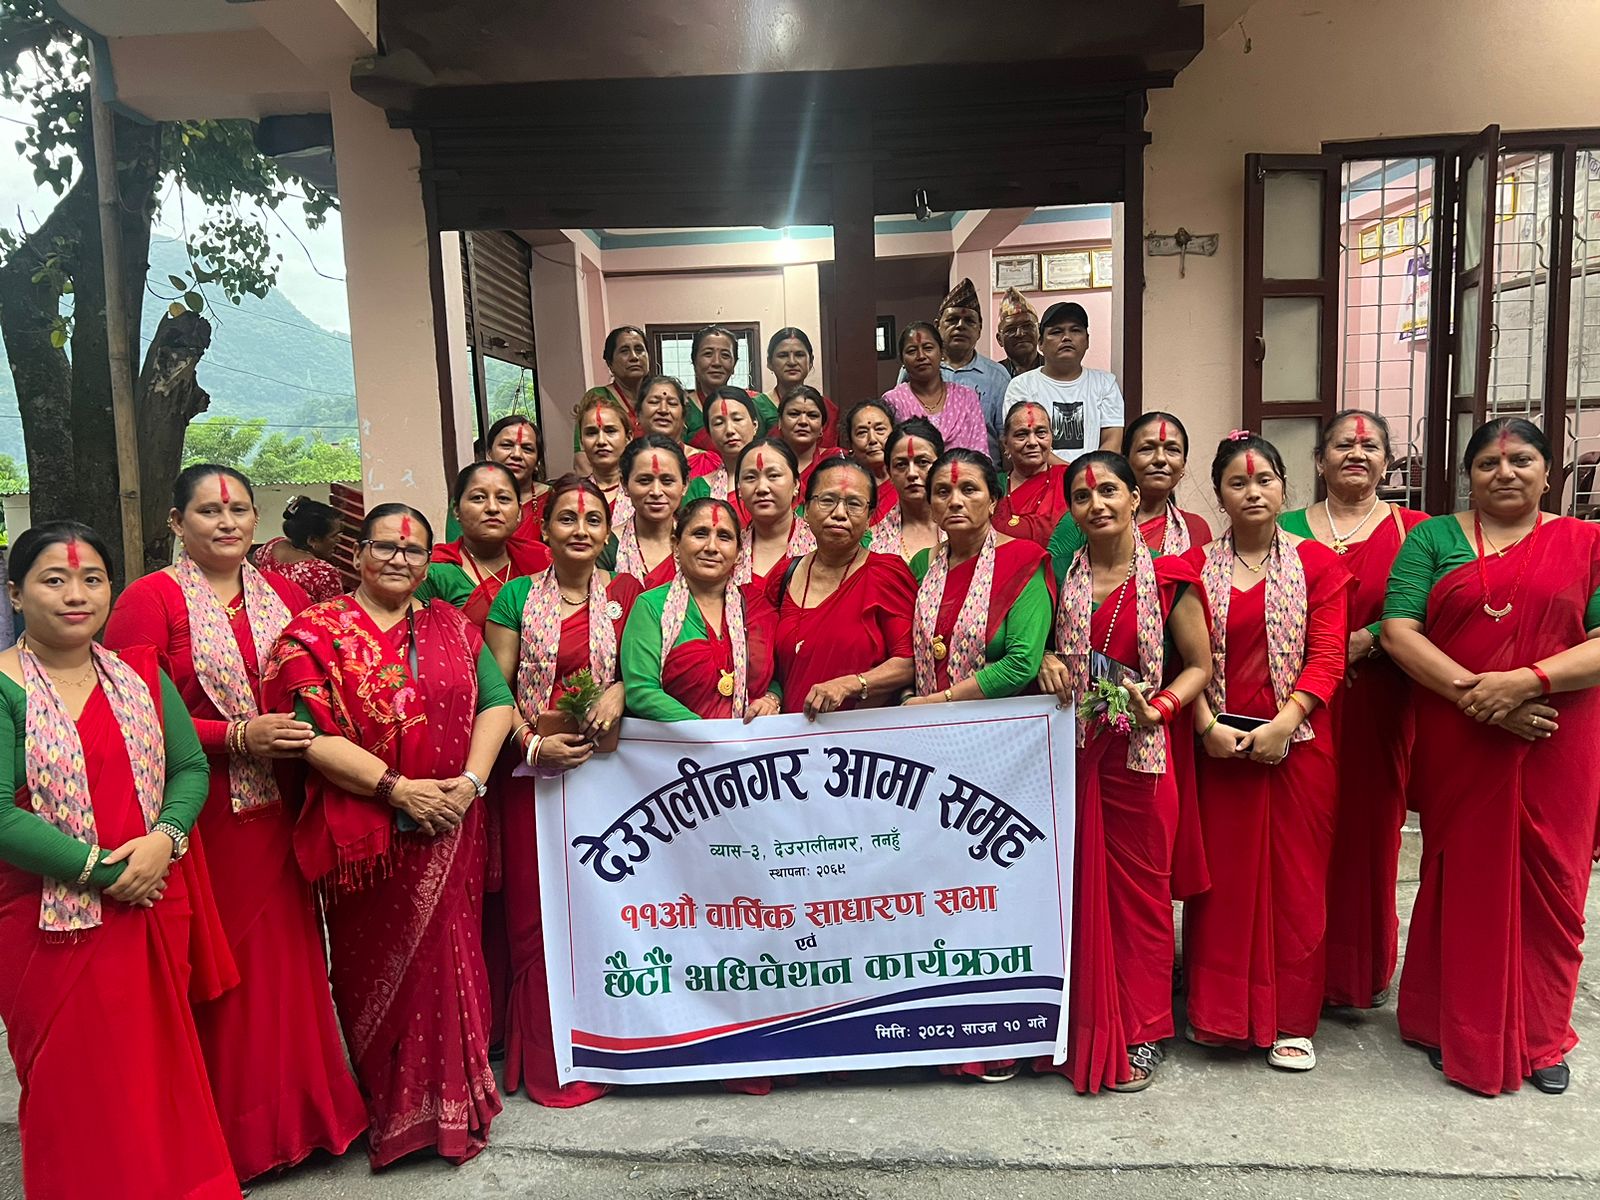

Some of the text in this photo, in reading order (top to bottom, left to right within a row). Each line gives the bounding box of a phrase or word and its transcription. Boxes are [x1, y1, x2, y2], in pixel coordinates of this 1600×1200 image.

[571, 747, 1047, 882] देउरालीनगर आमा समुह
[709, 827, 901, 861] व्यास-३, देउरालीनगर, तनहुँ
[816, 864, 846, 878] २०६९
[705, 896, 796, 931] वार्षिक
[804, 892, 925, 928] साधारण
[934, 885, 998, 915] सभा
[795, 933, 817, 951] एवं
[684, 953, 852, 992] अधिवेशन
[864, 939, 1033, 981] कार्यक्रम
[919, 1025, 955, 1039] २०८२
[961, 1021, 997, 1036] साउन
[1003, 1020, 1020, 1032] १०
[1027, 1014, 1047, 1029] गते
